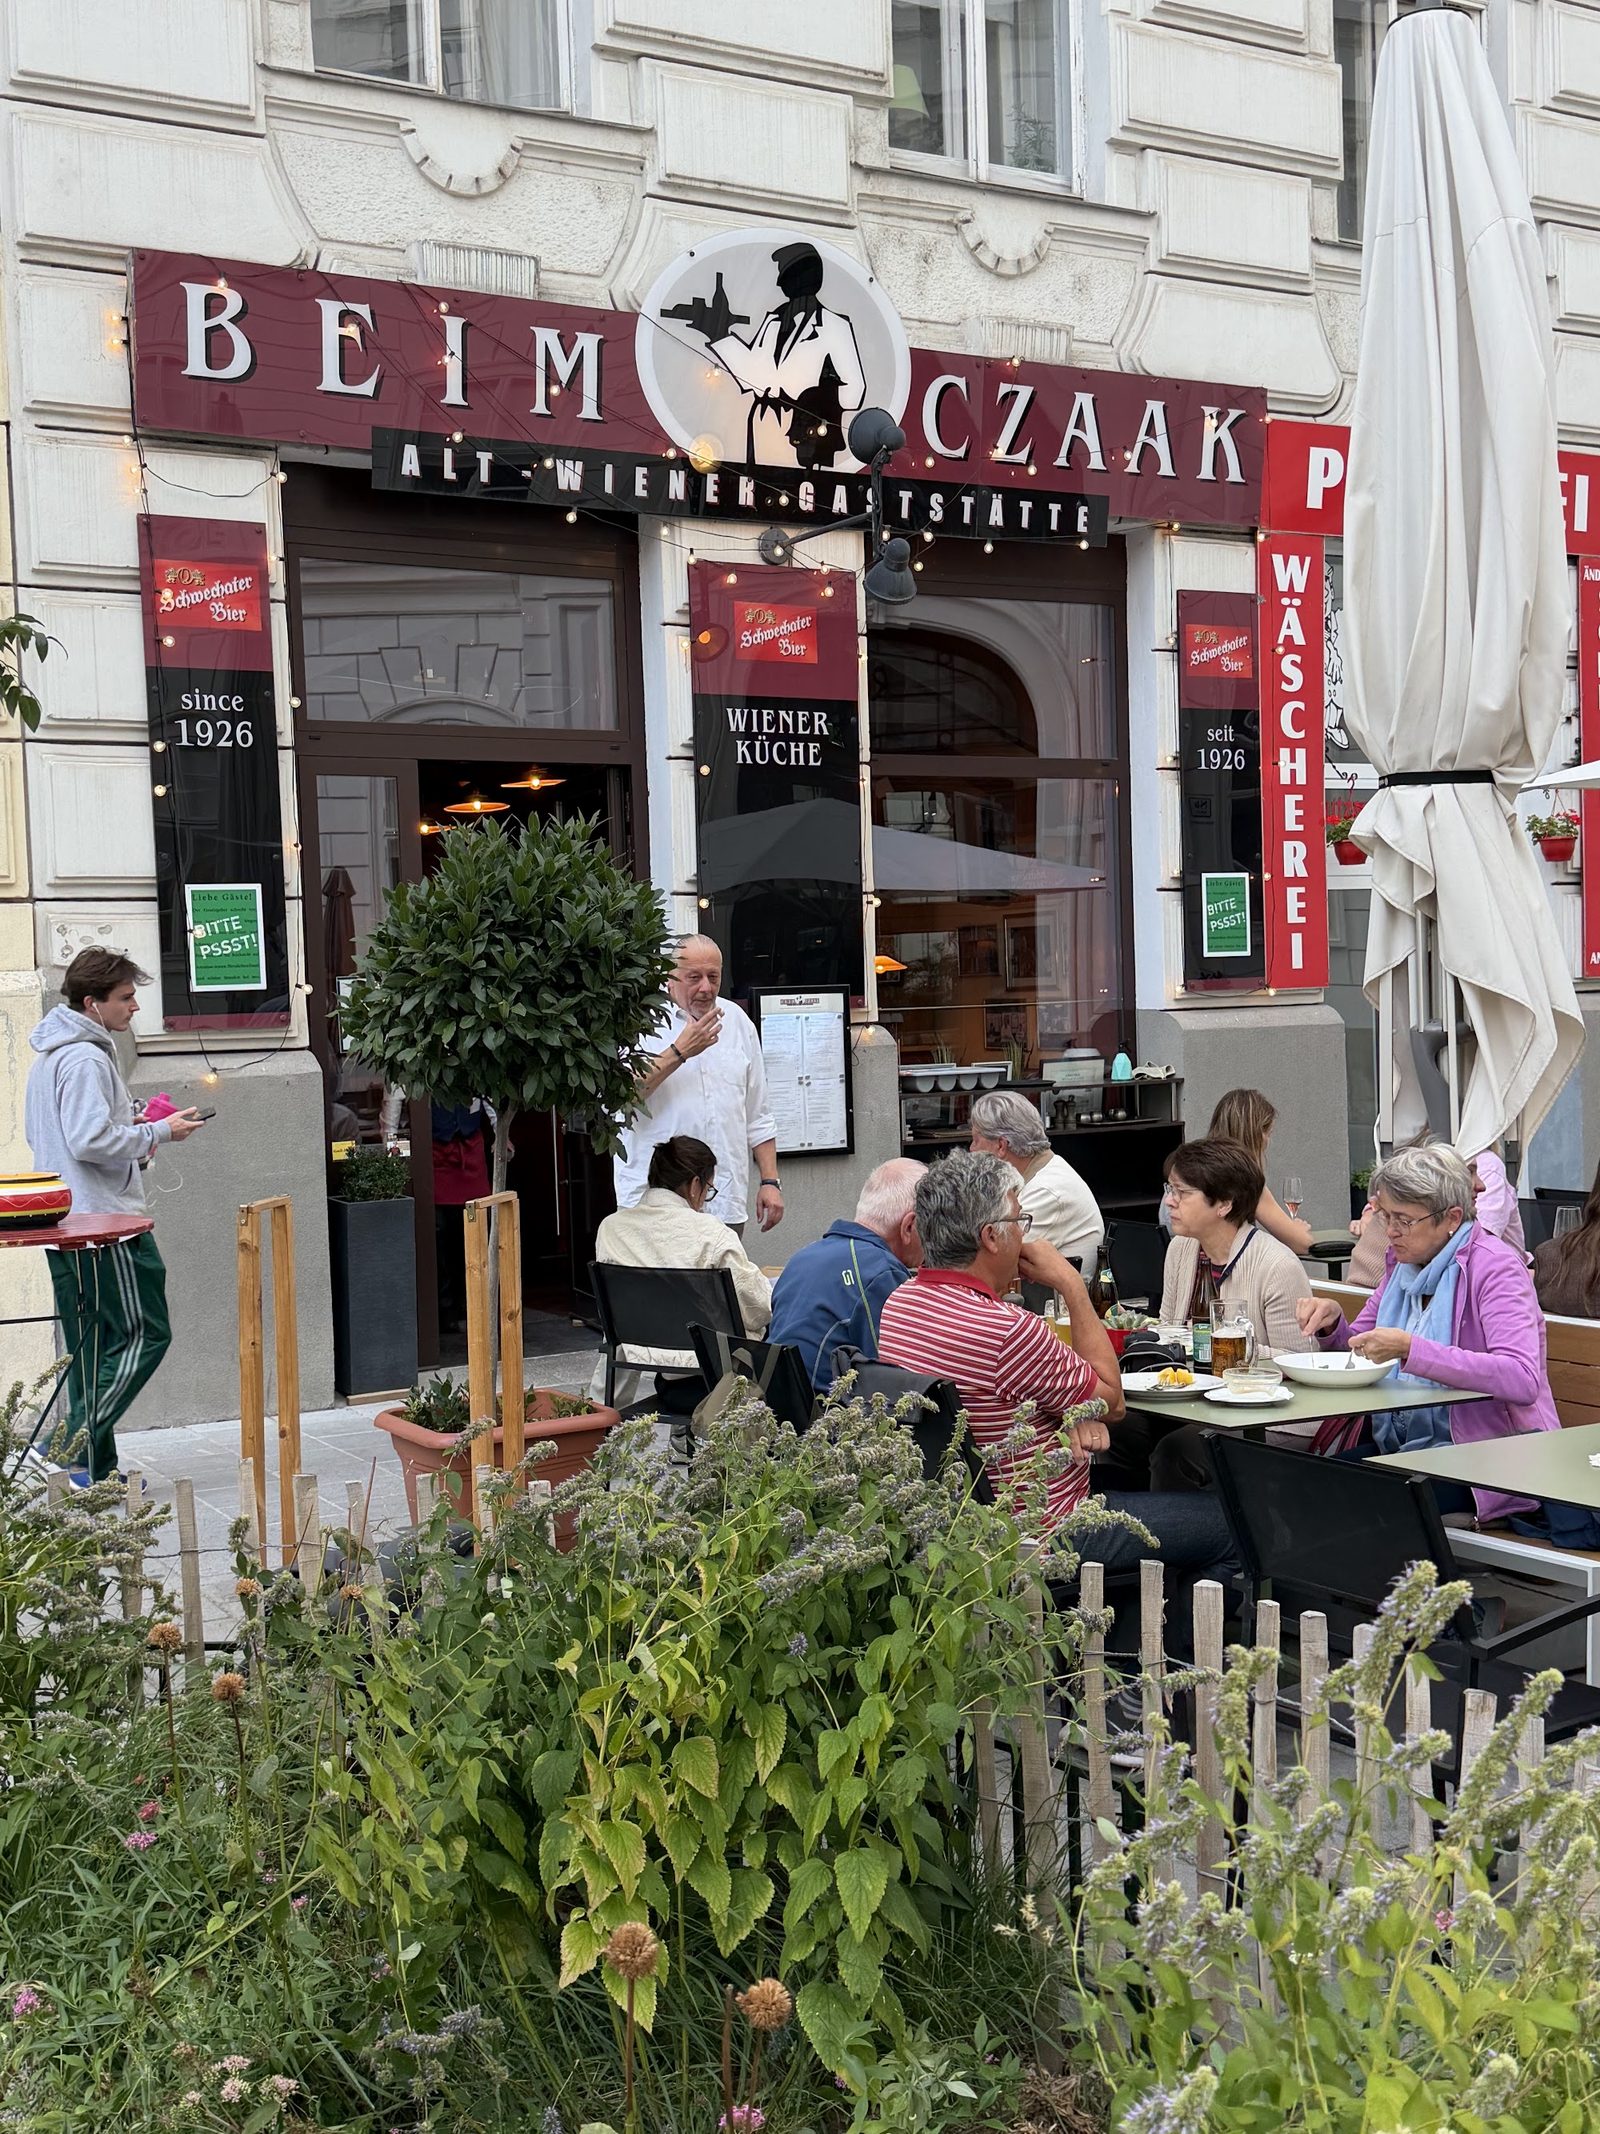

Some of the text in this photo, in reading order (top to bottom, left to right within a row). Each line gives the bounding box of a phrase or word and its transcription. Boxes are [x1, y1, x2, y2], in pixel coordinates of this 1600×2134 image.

[180, 281, 1248, 484] BEIM CZAAK
[158, 575, 253, 613] Schwechater
[210, 602, 247, 622] Bier
[740, 616, 812, 649] Schwechater
[778, 638, 806, 657] Bier
[1190, 635, 1248, 667] Schwechater
[1220, 656, 1244, 672] Bier
[181, 688, 244, 712] since
[174, 719, 254, 748] 1926
[726, 708, 829, 736] WIENER
[1207, 724, 1235, 742] seit
[736, 735, 822, 766] KÜCHE
[1197, 748, 1246, 770] 1926
[1271, 553, 1311, 971] WÄSCHEREI
[1207, 897, 1237, 916] BITTE
[1210, 911, 1246, 932] PSSST!
[200, 933, 258, 960] PSSST!
